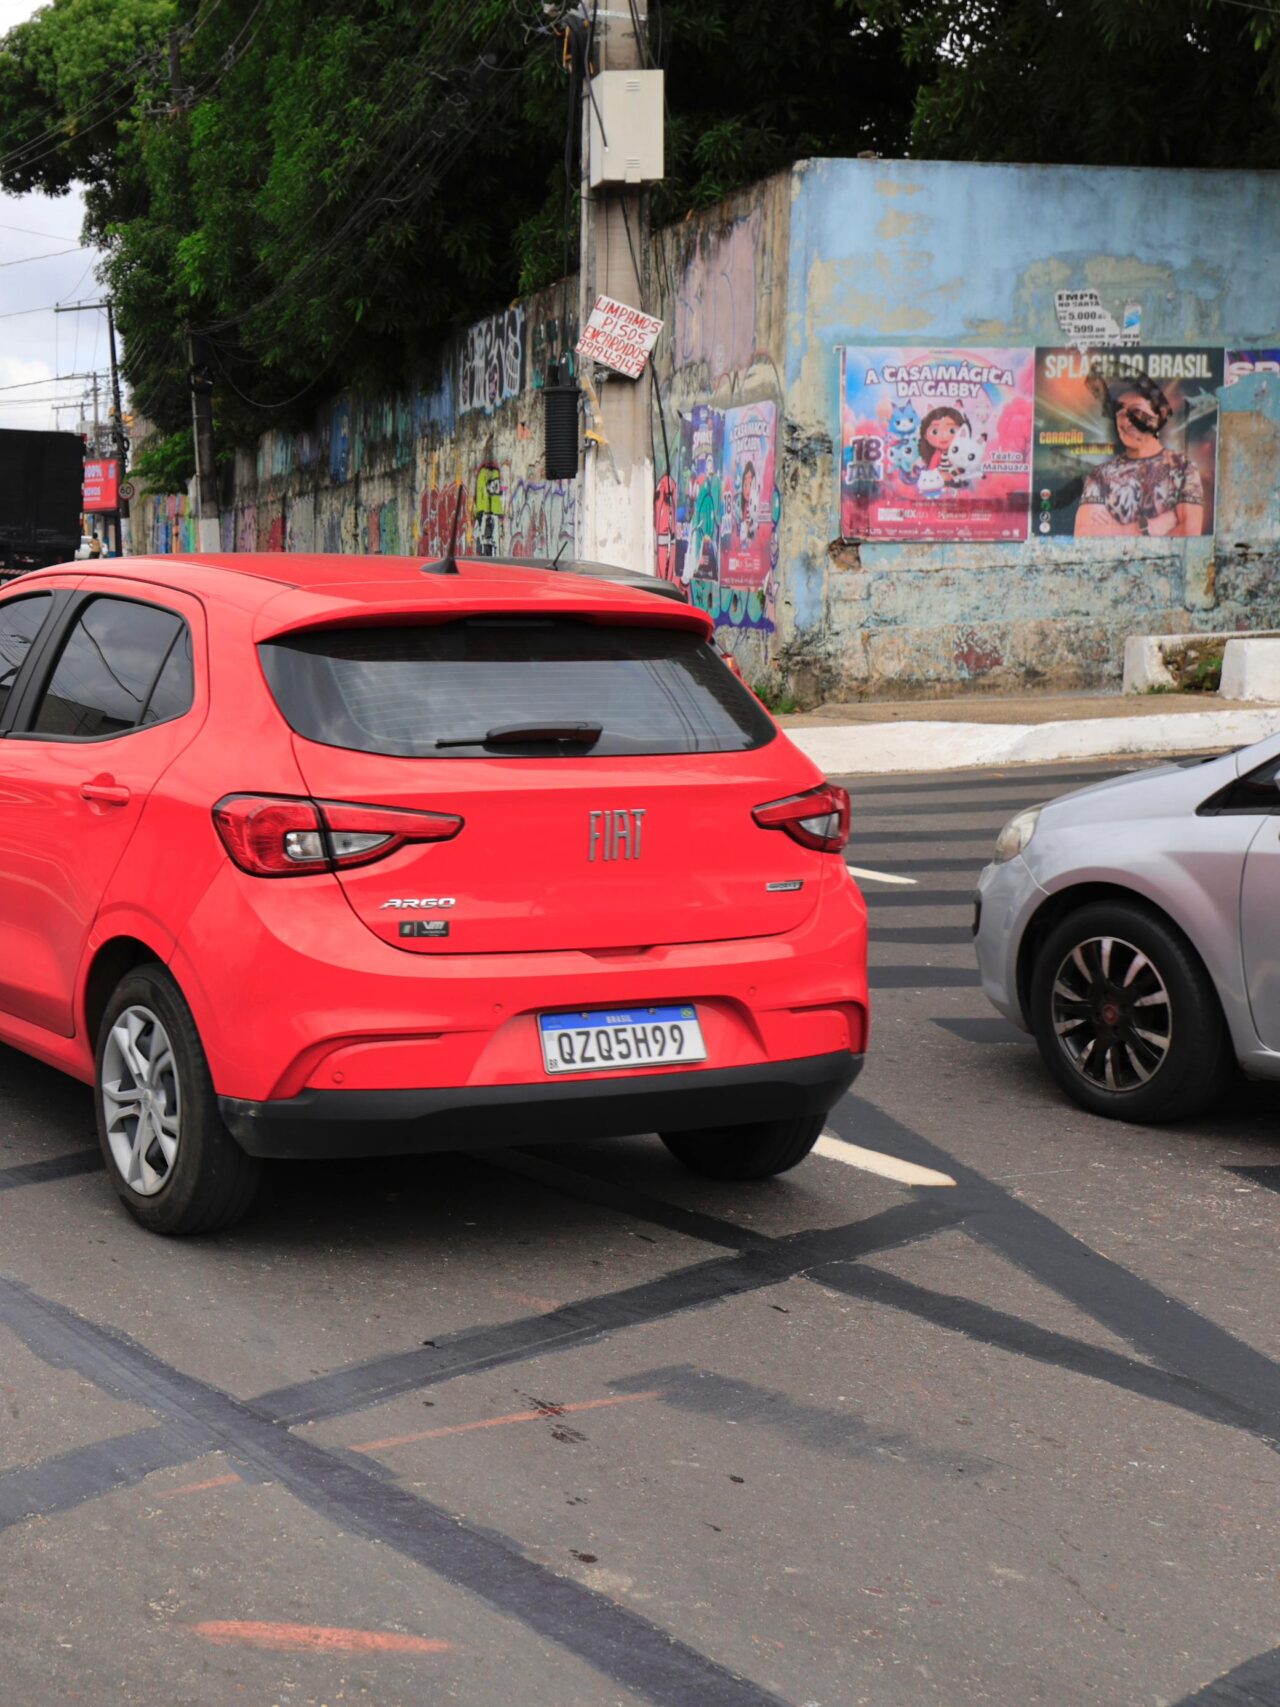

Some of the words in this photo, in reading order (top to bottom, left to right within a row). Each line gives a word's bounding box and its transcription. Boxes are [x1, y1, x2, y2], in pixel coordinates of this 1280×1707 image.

[594, 297, 661, 334] LIMPAMOS
[601, 317, 648, 344] PISOS
[576, 338, 644, 376] 99194-2147
[582, 325, 650, 364] ENCARDIDOS
[865, 369, 880, 385] A
[883, 365, 932, 382] CASA
[936, 360, 1014, 386] MÁGICA
[1119, 354, 1144, 378] DO
[1148, 354, 1213, 379] BRASIL
[897, 382, 921, 398] DA
[922, 381, 981, 398] GABBY
[852, 437, 883, 462] 18
[1039, 429, 1084, 445] CORAÇÃO
[982, 463, 1029, 471] Manauara
[991, 452, 1021, 460] Teatro
[847, 464, 882, 481] JAN
[120, 486, 132, 495] 60
[588, 808, 647, 862] FIAT
[379, 897, 456, 910] ARGO
[606, 1015, 633, 1024] BRASIL
[557, 1024, 685, 1064] QZQ5H99
